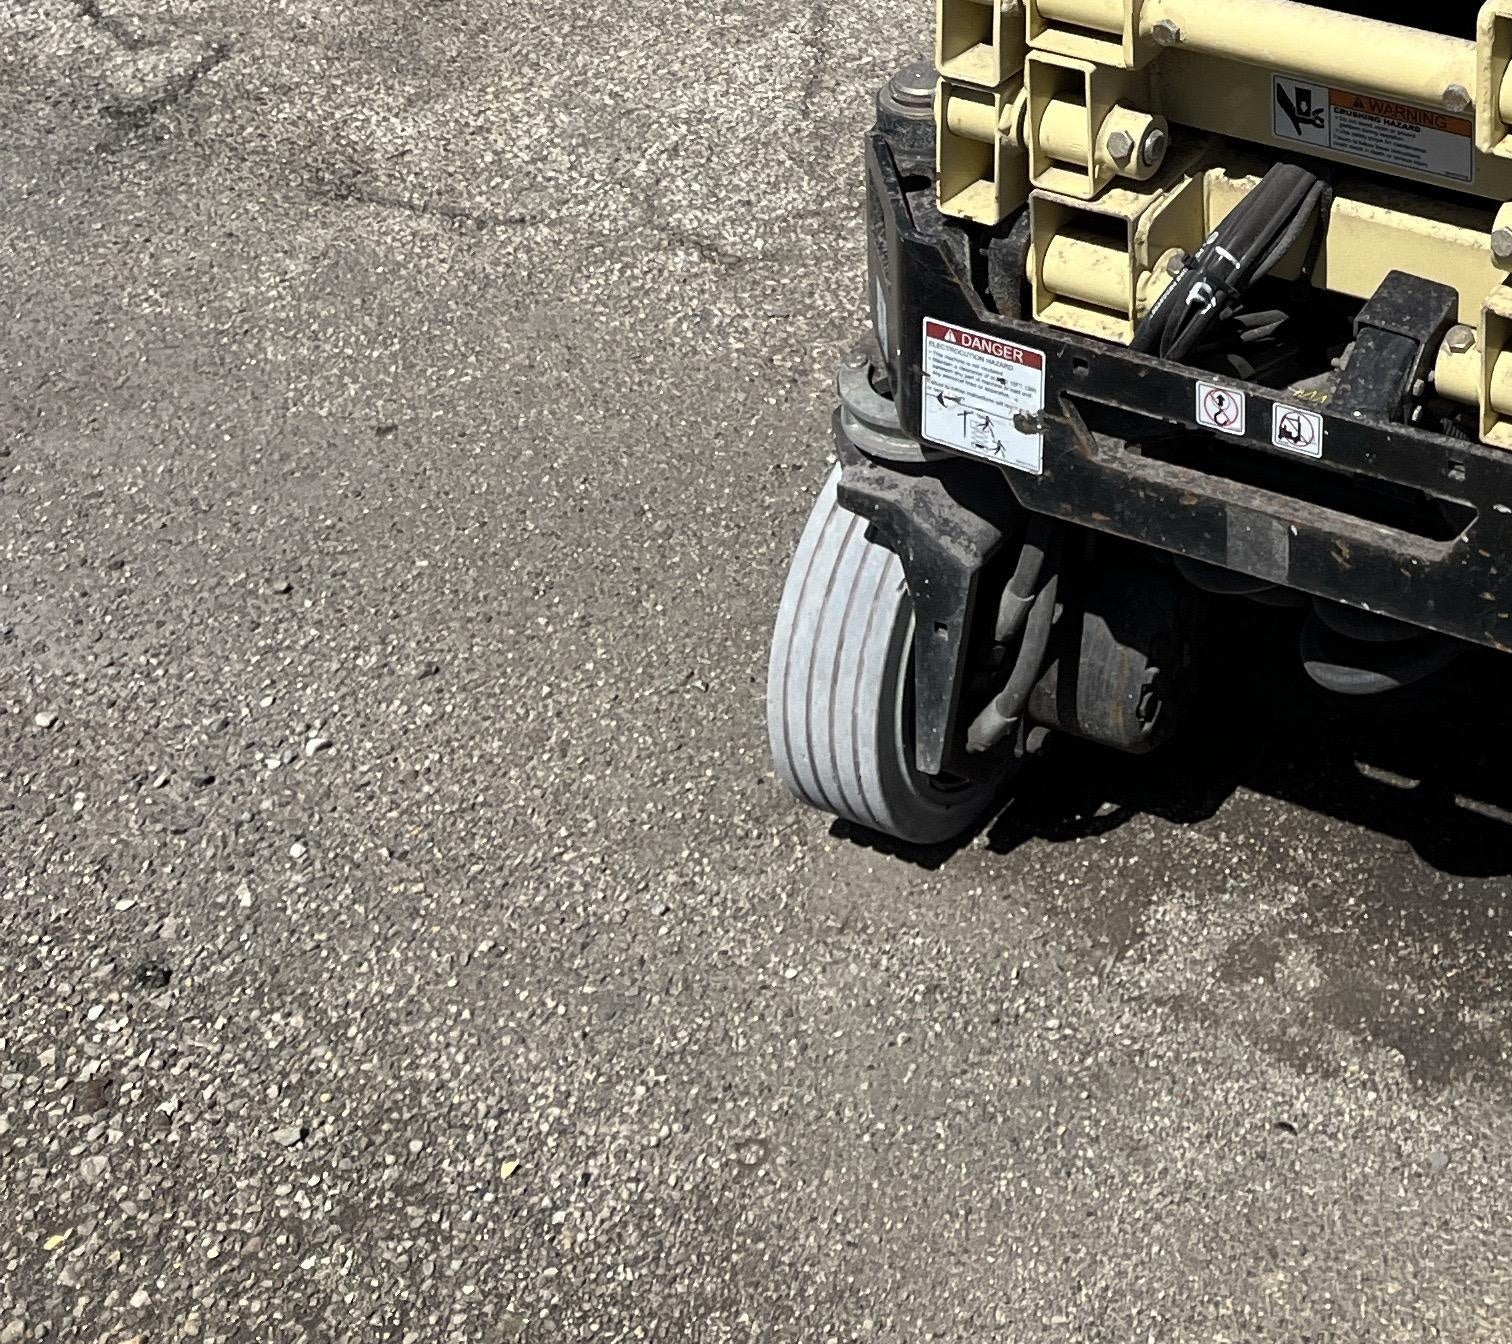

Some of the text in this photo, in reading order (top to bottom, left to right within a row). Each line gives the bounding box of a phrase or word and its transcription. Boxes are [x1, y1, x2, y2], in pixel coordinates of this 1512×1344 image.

[1368, 98, 1448, 129] WARNING
[1383, 116, 1421, 133] HAZARD
[961, 333, 1024, 364] DANGER
